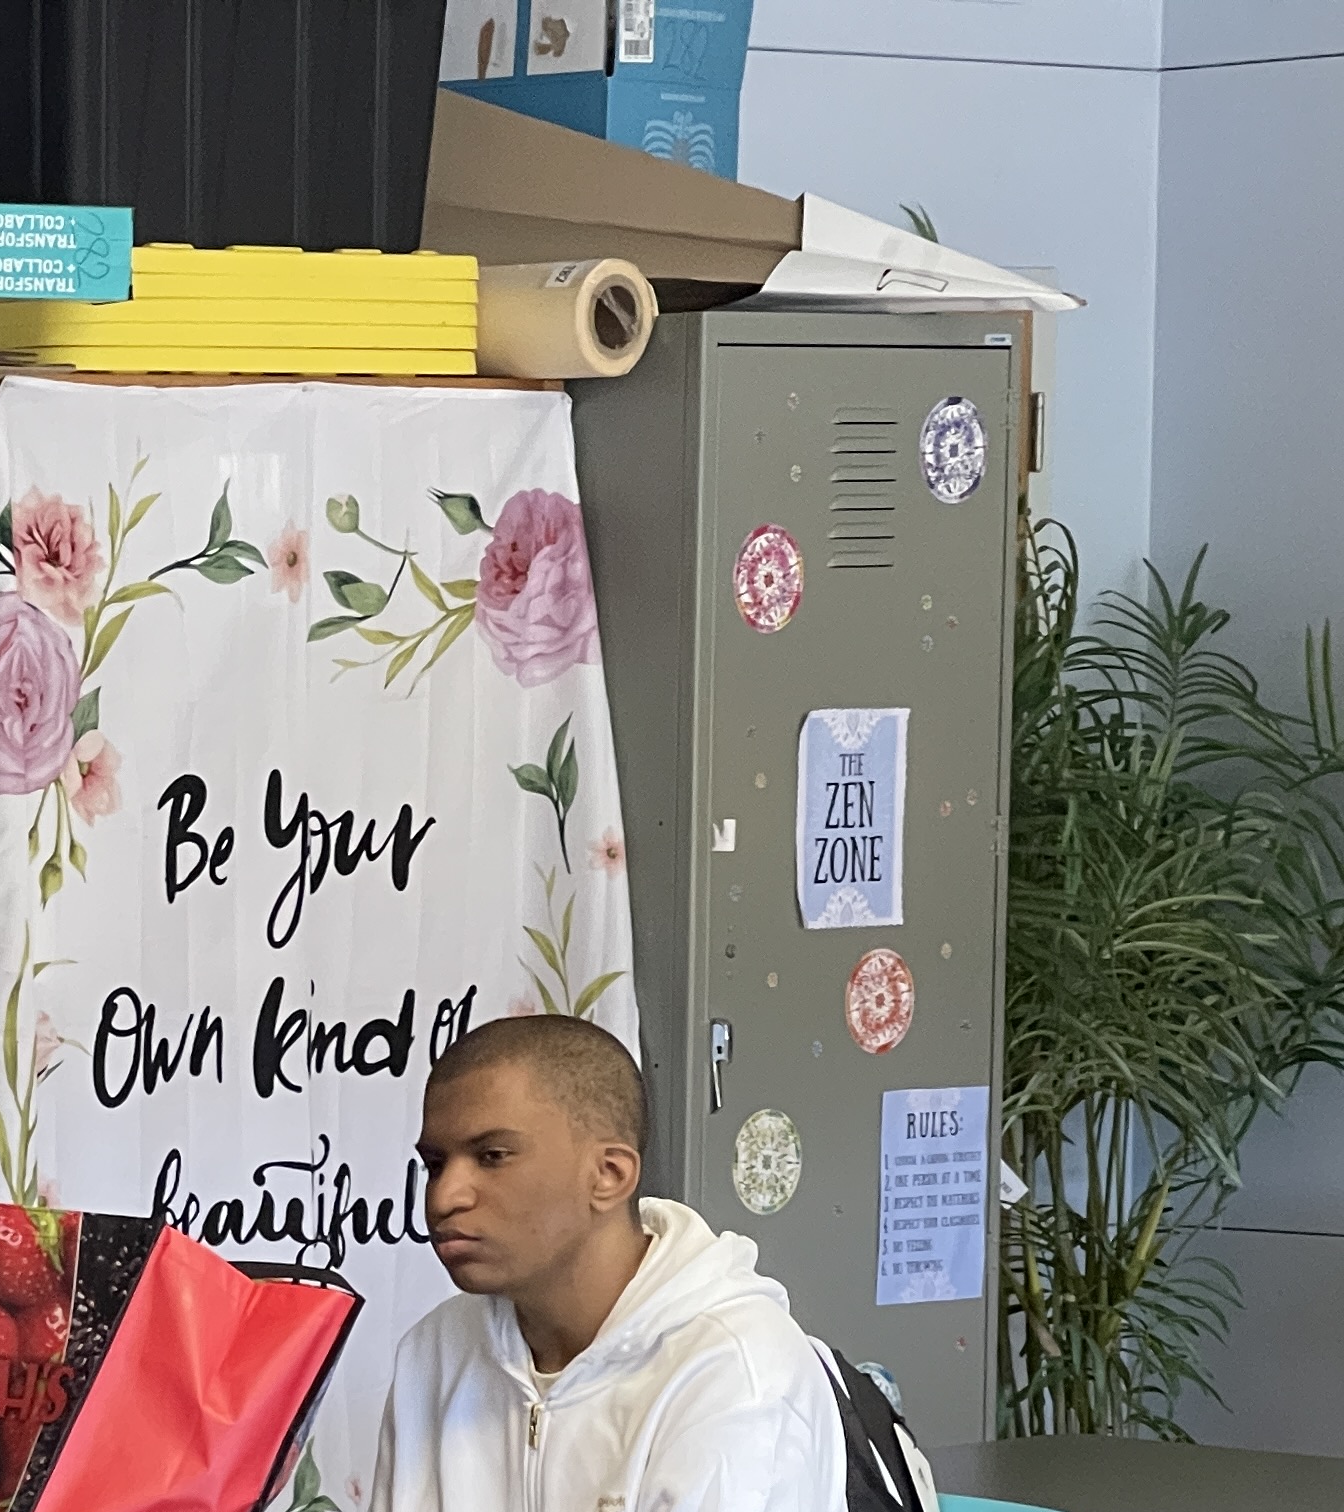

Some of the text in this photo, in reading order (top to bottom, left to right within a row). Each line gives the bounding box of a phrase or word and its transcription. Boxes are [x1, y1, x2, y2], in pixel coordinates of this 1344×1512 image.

[839, 754, 865, 776] THE
[825, 781, 875, 829] ZEN
[157, 774, 235, 903] Be
[814, 836, 883, 883] ZONE
[93, 986, 224, 1108] Own
[906, 1111, 964, 1140] RULES:
